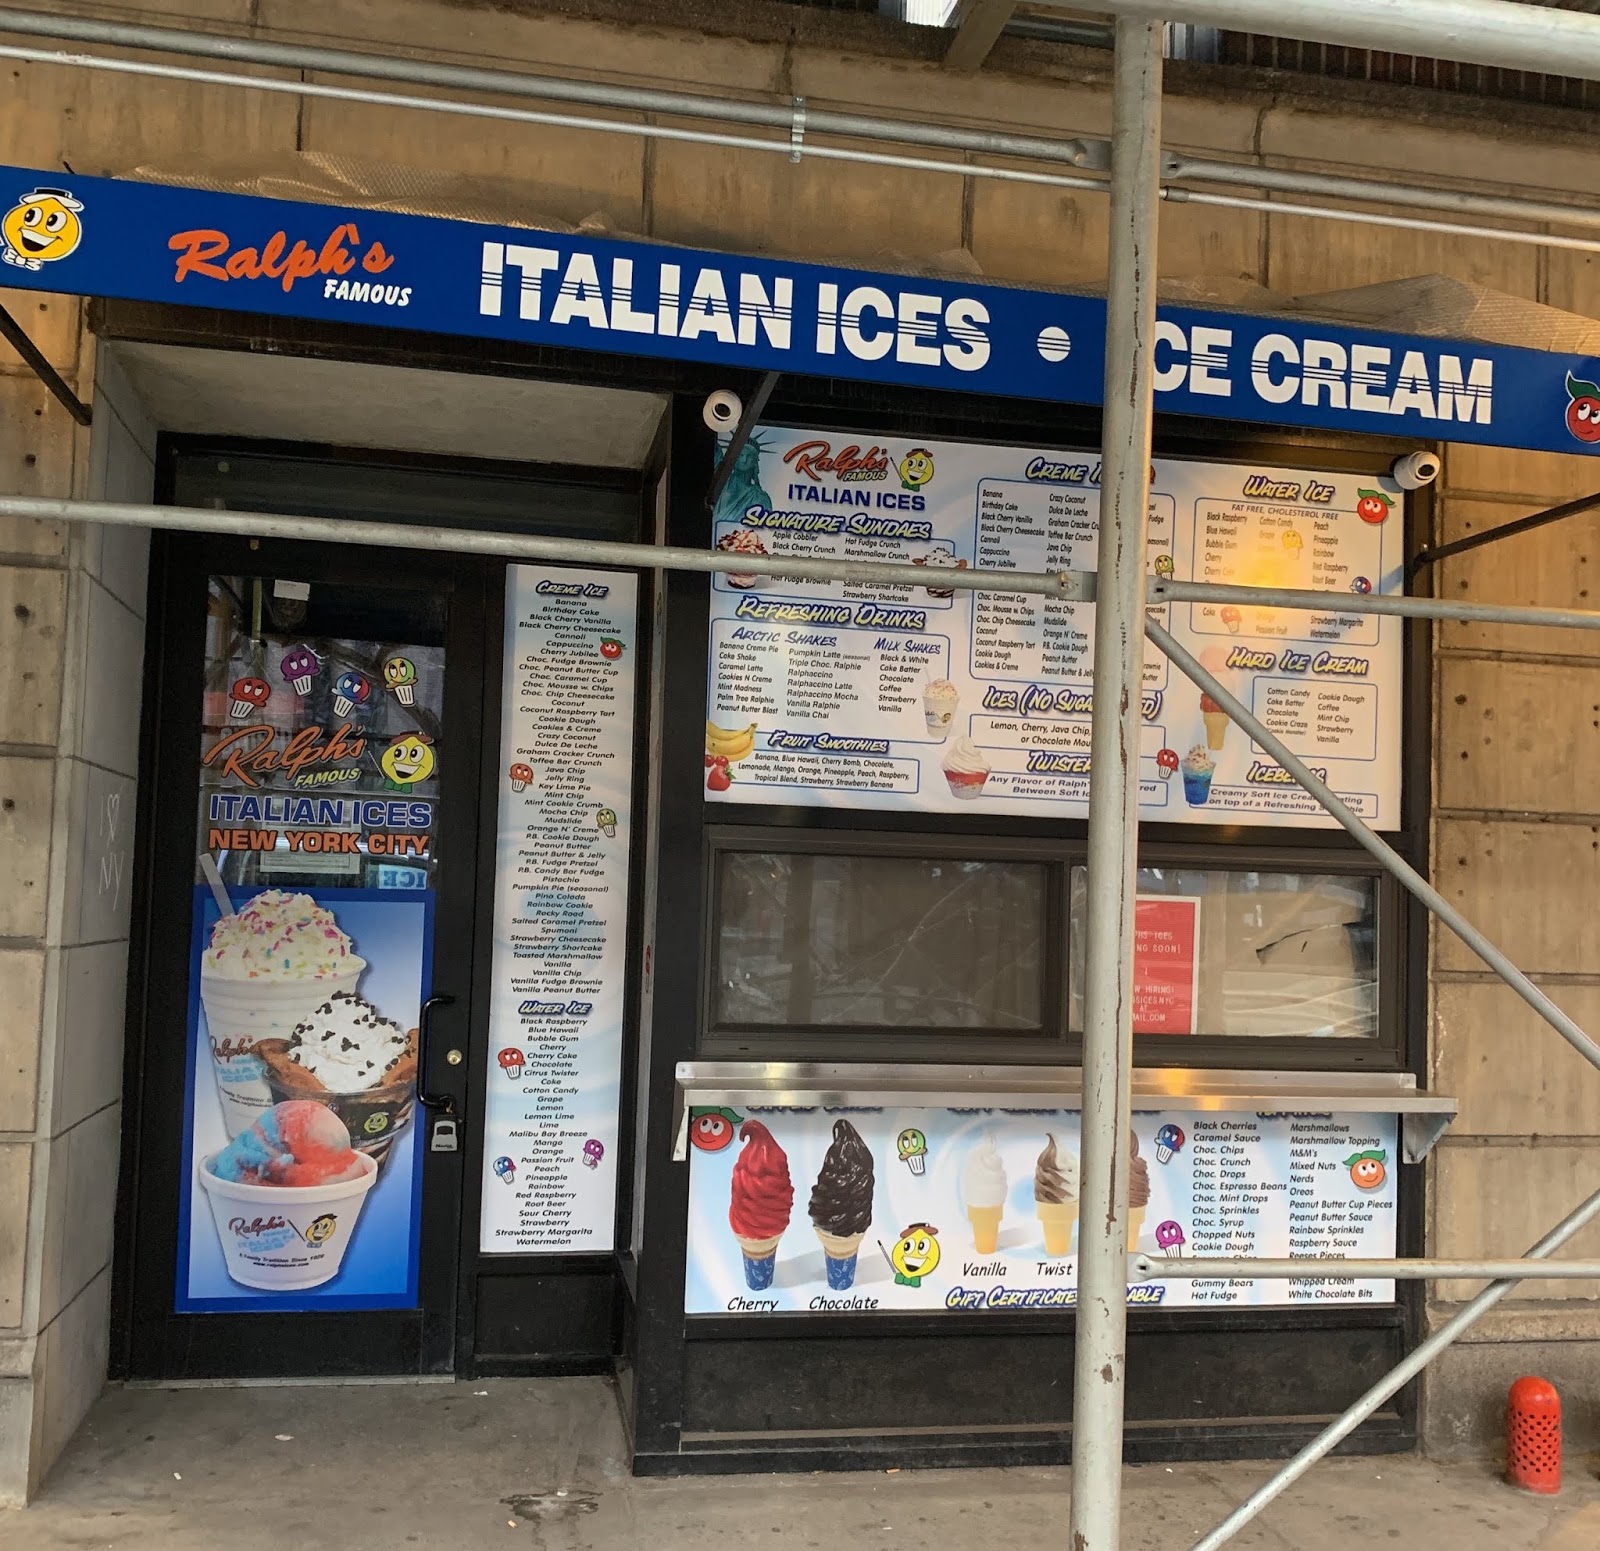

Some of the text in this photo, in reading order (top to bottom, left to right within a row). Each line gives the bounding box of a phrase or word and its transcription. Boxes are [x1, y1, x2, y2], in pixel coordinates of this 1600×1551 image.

[168, 223, 412, 306] Ralph's FAMOUS
[479, 242, 795, 350] ITALIAN
[816, 282, 991, 372] ICES
[1154, 319, 1494, 424] CE CREAM
[783, 440, 888, 481] Ralph's
[1026, 457, 1088, 481] CREME
[844, 471, 887, 482] FAMOUS
[983, 490, 1003, 498] Banana
[1243, 476, 1335, 502] WATER ICE
[788, 484, 925, 511] ITALIAN ICES
[1050, 494, 1085, 504] Crazy Coconut
[1268, 507, 1320, 518] CHOLESTEROL
[742, 506, 932, 539] SIGNATURE SUNDAES
[981, 514, 996, 523] Black
[997, 515, 1014, 525] Cherry
[1222, 514, 1247, 523] Raspberry
[773, 532, 818, 542] Apple Cobbler
[844, 549, 909, 560] Marshmallow Crunch
[536, 580, 608, 597] CREME ICE
[843, 590, 909, 602] Strawberry Shortcake
[542, 607, 577, 615] Birthday
[736, 596, 926, 629] REFRESHING DRINKS
[732, 627, 837, 646] ARCTIC SHAKES
[546, 641, 593, 649] Cappuccino
[874, 638, 941, 654] MILK SHAKES
[789, 649, 840, 659] Pumpkin Latte
[789, 659, 861, 671] Triple Choc. Ralphie
[1226, 647, 1369, 675] HARD ICE CREAM
[788, 669, 833, 679] Ralphaccino
[880, 665, 897, 673] Cake
[880, 675, 914, 683] Chocolate
[878, 694, 916, 704] Strawberry
[983, 687, 1018, 710] ICES
[1051, 725, 1069, 734] Java
[1317, 725, 1353, 735] Strawberry
[768, 730, 889, 753] FRUIT SMOOTHIES
[203, 723, 366, 787] Ralph's
[294, 767, 361, 789] FAMOUS
[210, 794, 432, 828] ITALIAN ICES
[209, 829, 429, 855] NEW YORK CITY
[541, 927, 578, 935] Spumoni
[510, 935, 556, 943] Strawberry
[518, 1001, 592, 1015] WATER ICE
[539, 1044, 566, 1052] Cherry
[1194, 1122, 1257, 1130] Black Cherries
[1290, 1124, 1349, 1132] Marshmallows
[1194, 1134, 1231, 1142] Caramel
[1290, 1137, 1380, 1147] Marshmallow Topping
[532, 1148, 563, 1156] Orange
[1290, 1150, 1317, 1158] M&M's
[1193, 1158, 1251, 1166] Choc. Crunch
[1290, 1162, 1336, 1170] Mixed Nuts
[1290, 1175, 1314, 1183] Nerds
[1193, 1182, 1287, 1193] Choc. Espresso Beans
[1290, 1188, 1314, 1196] Oreos
[1290, 1200, 1392, 1211] Peanut Butter Cup Pieces
[1193, 1206, 1259, 1217] Choc. Sprinkles
[520, 1219, 569, 1227] Strawberry
[1193, 1231, 1255, 1241] Chopped Nuts
[1289, 1226, 1364, 1236] Rainbow Sprinkles
[1192, 1243, 1254, 1253] Cookie Dough
[1289, 1239, 1357, 1249] Raspberry Sauce
[962, 1263, 1072, 1277] Vanilla Twist
[1191, 1279, 1253, 1290] Gummy Bears
[946, 1286, 986, 1308] GIFT
[1191, 1291, 1238, 1301] Hot Fudge
[1288, 1289, 1372, 1298] White Chocolate Bits
[727, 1296, 878, 1312] Cherry Chocolate
